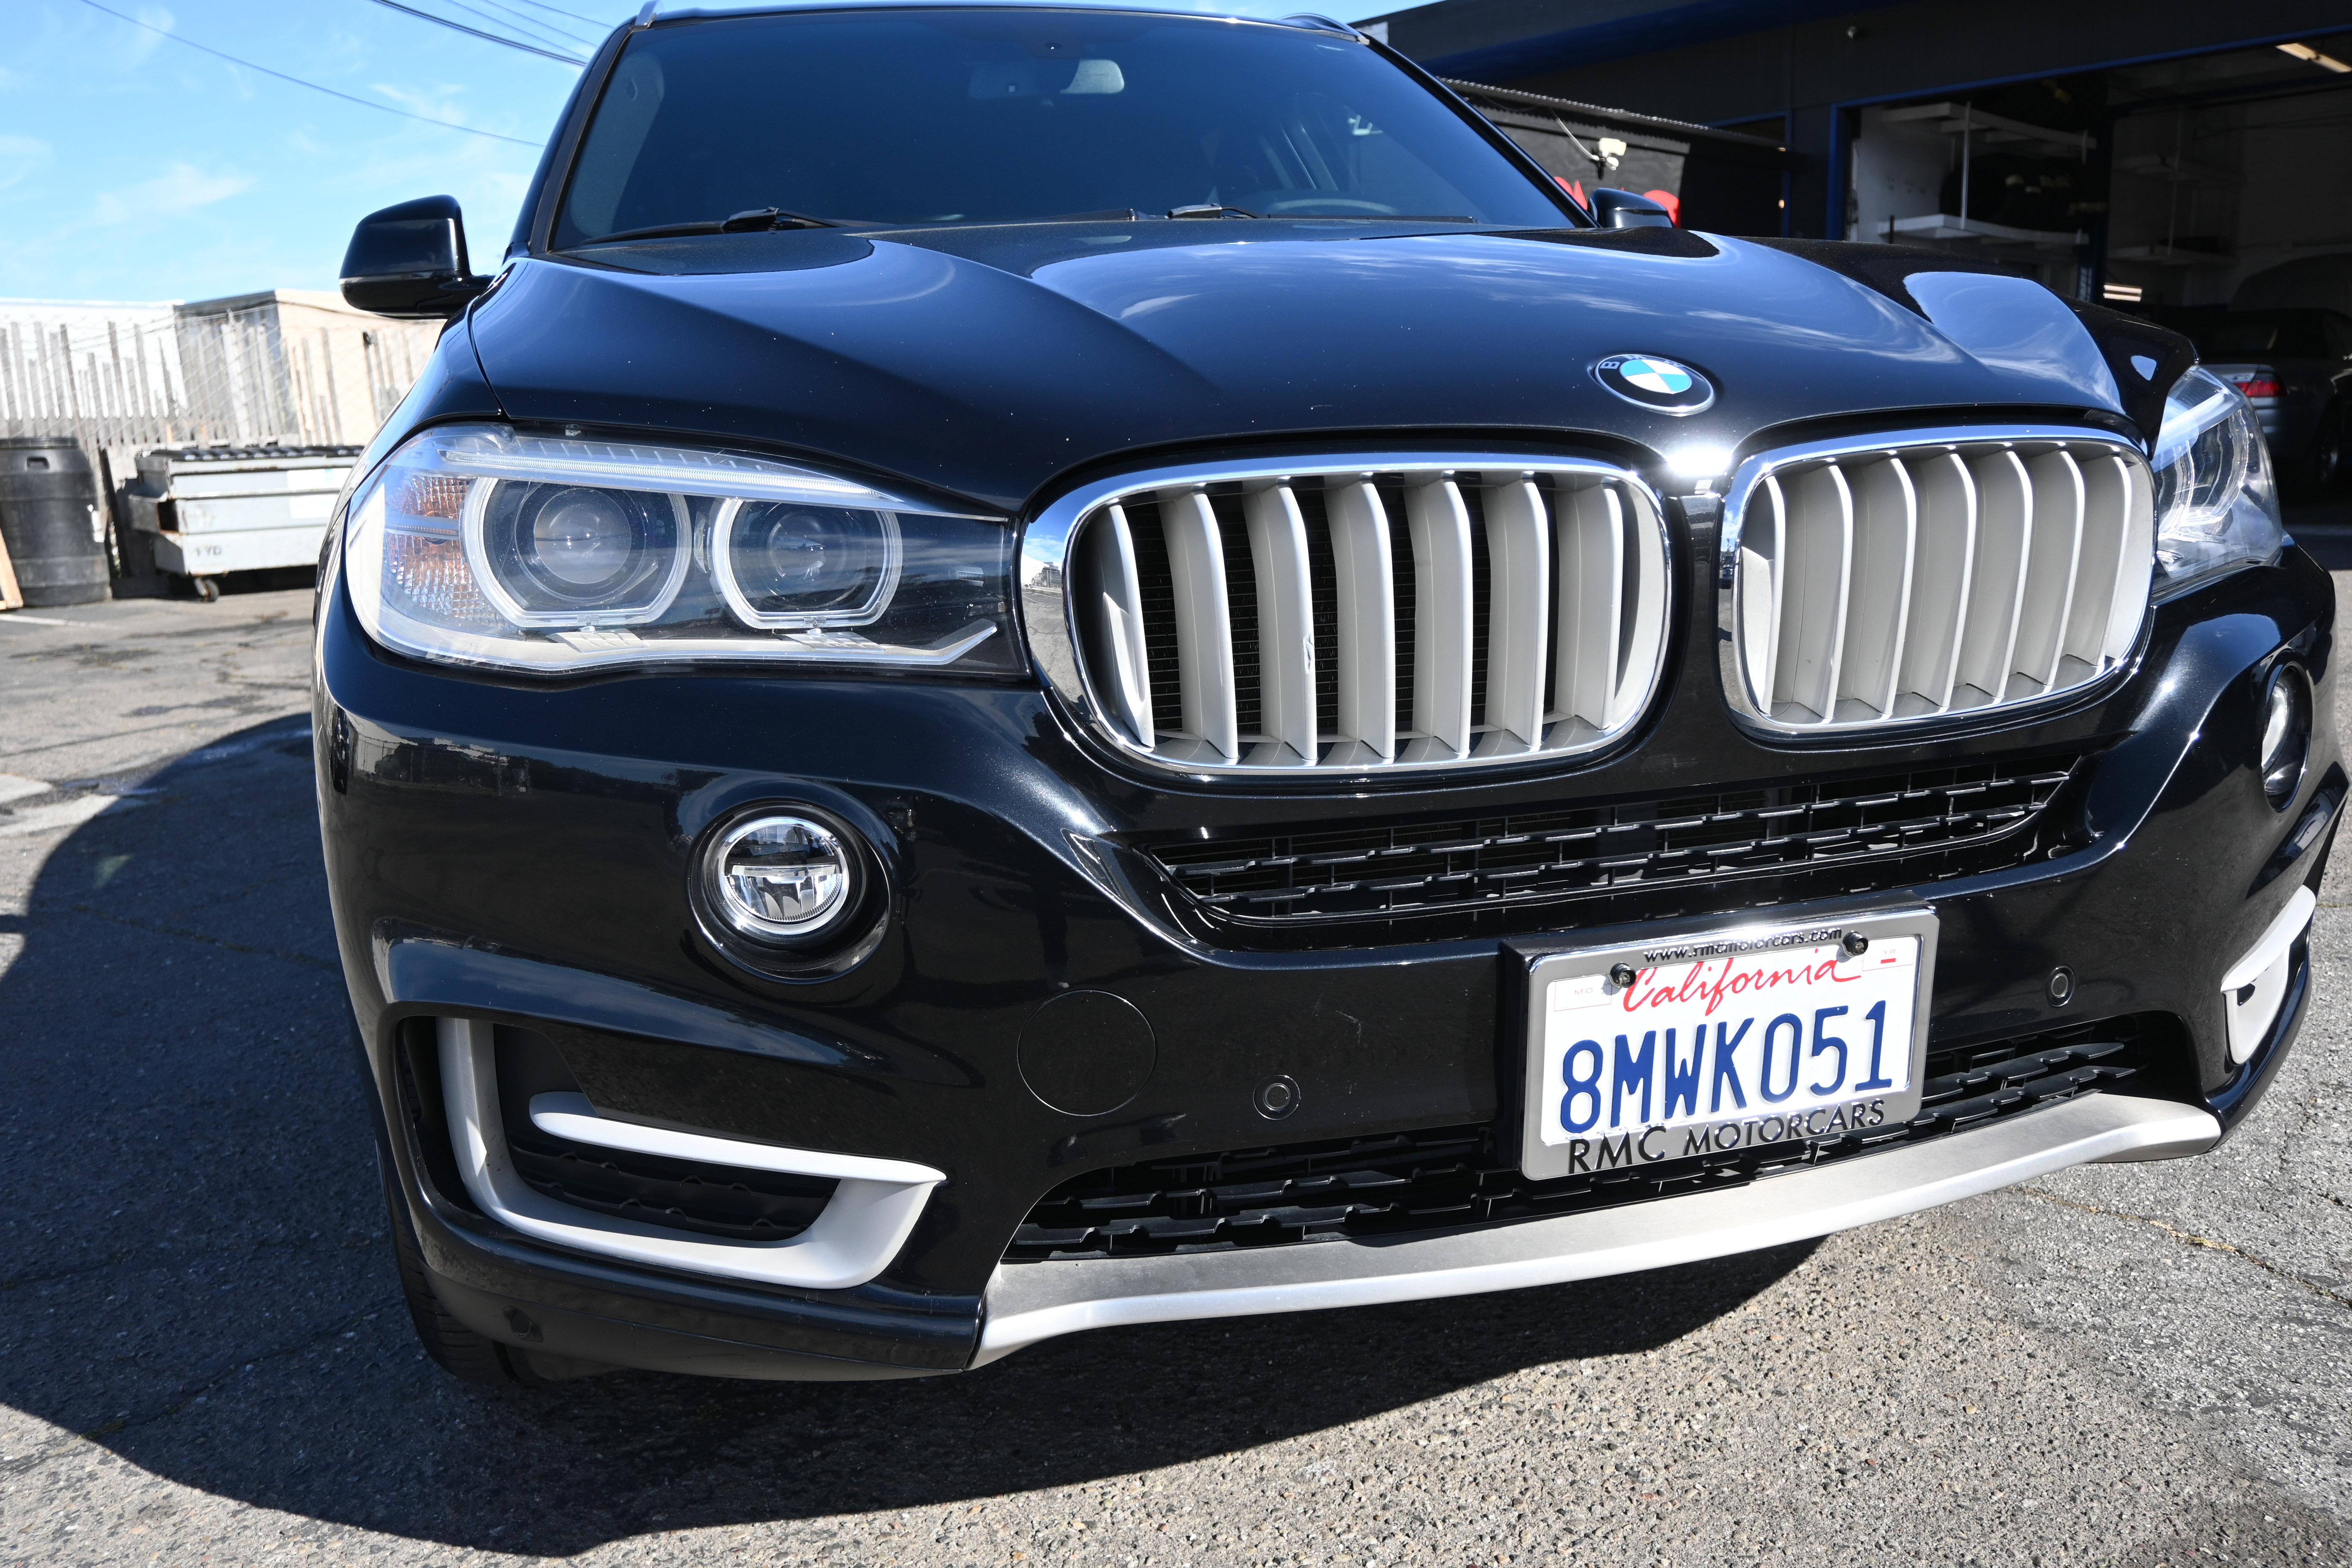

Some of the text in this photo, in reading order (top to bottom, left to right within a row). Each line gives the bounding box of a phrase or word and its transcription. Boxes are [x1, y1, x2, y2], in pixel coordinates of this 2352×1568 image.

[1643, 928, 1843, 963] www.rmcmotorcars.com
[1623, 948, 1862, 1016] California
[1560, 1000, 1892, 1134] 8MWK051
[1568, 1098, 1885, 1174] RMC MOTORCARS
